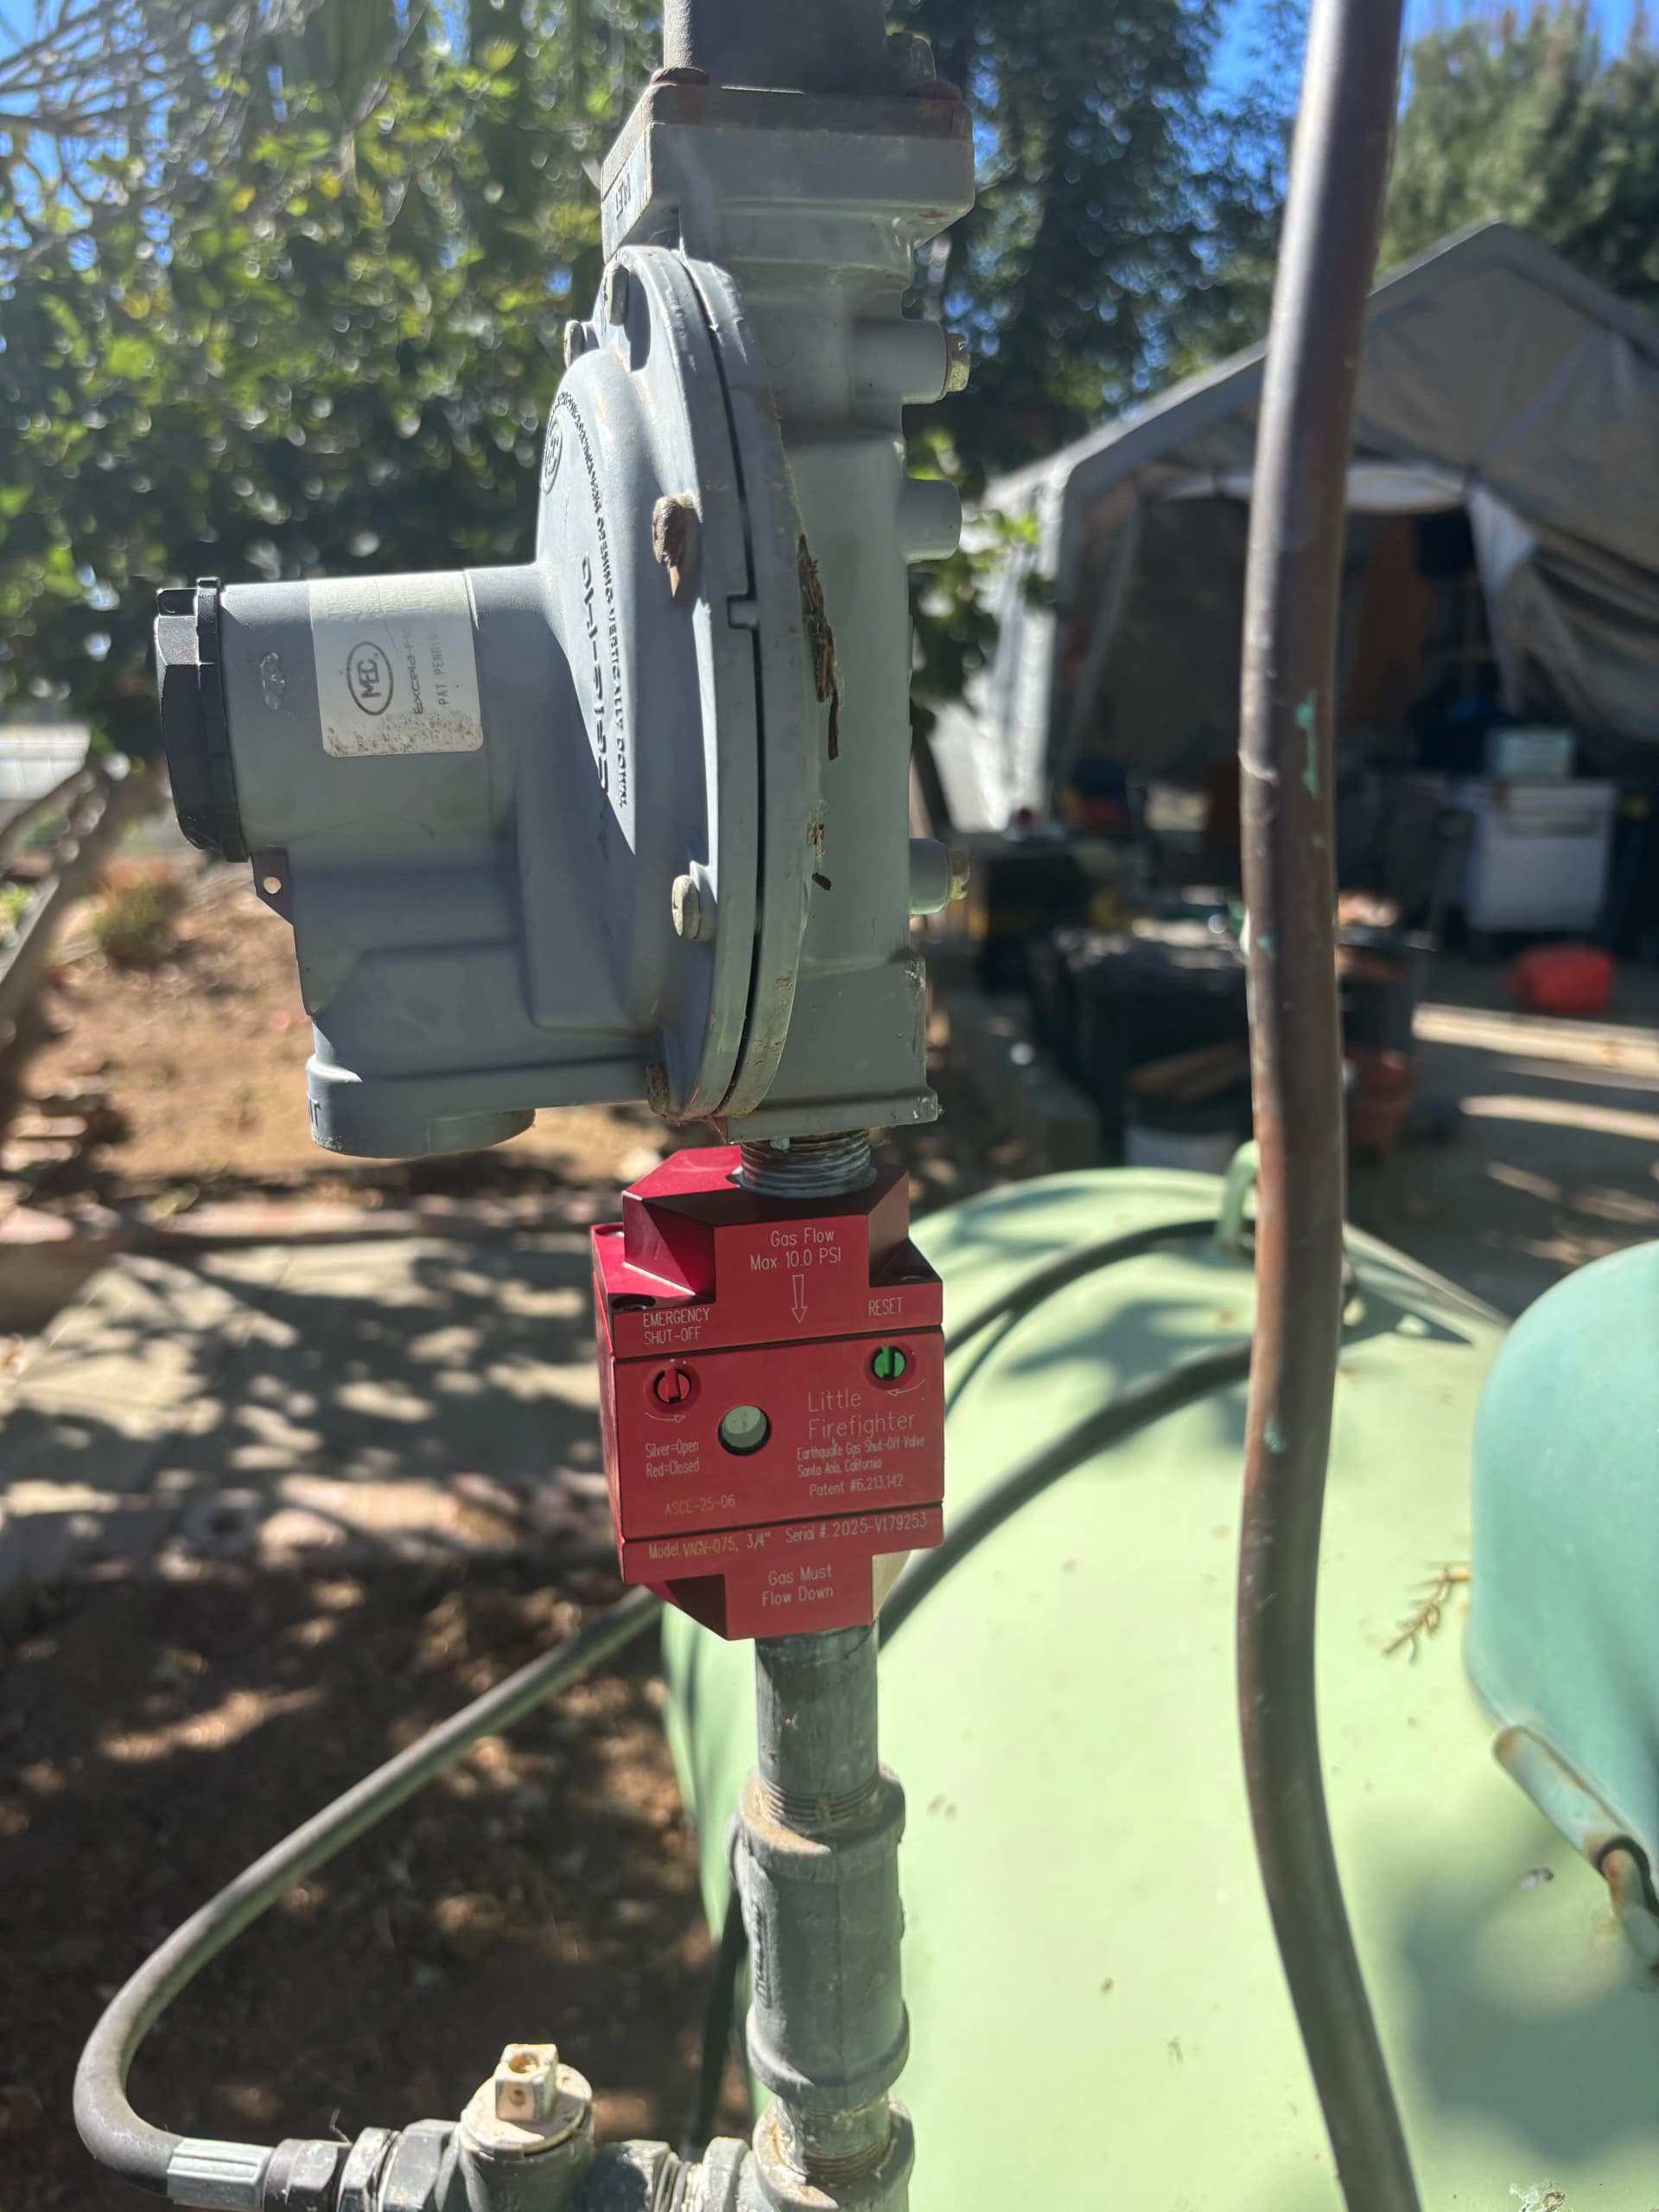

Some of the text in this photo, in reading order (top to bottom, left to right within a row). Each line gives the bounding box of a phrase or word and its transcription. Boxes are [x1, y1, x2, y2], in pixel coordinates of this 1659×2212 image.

[608, 608, 624, 729] VERTICALLY
[435, 683, 449, 705] PAT
[771, 1227, 835, 1247] Gas Flow
[750, 1247, 842, 1271] Max 10.0 PSI
[643, 1307, 710, 1328] EMERGENCY
[868, 1297, 903, 1316] RESET
[645, 1325, 702, 1345] SHUT-OFF
[808, 1389, 861, 1412] Little
[809, 1412, 915, 1439] Firefighter
[645, 1438, 699, 1459] Silver=Open
[797, 1435, 925, 1461] Earthquake Gas Shut-Off Valve
[646, 1457, 700, 1479] Red=Closed
[798, 1463, 821, 1478] Santa
[844, 1458, 882, 1472] California
[810, 1481, 844, 1497] Patent
[664, 1493, 735, 1515] ASCE-25-06
[747, 1531, 772, 1549] 3/4"
[785, 1527, 815, 1544] Serial
[833, 1512, 927, 1537] 2025-V179253
[768, 1563, 832, 1586] Gas Must
[762, 1585, 834, 1607] Flow Down
